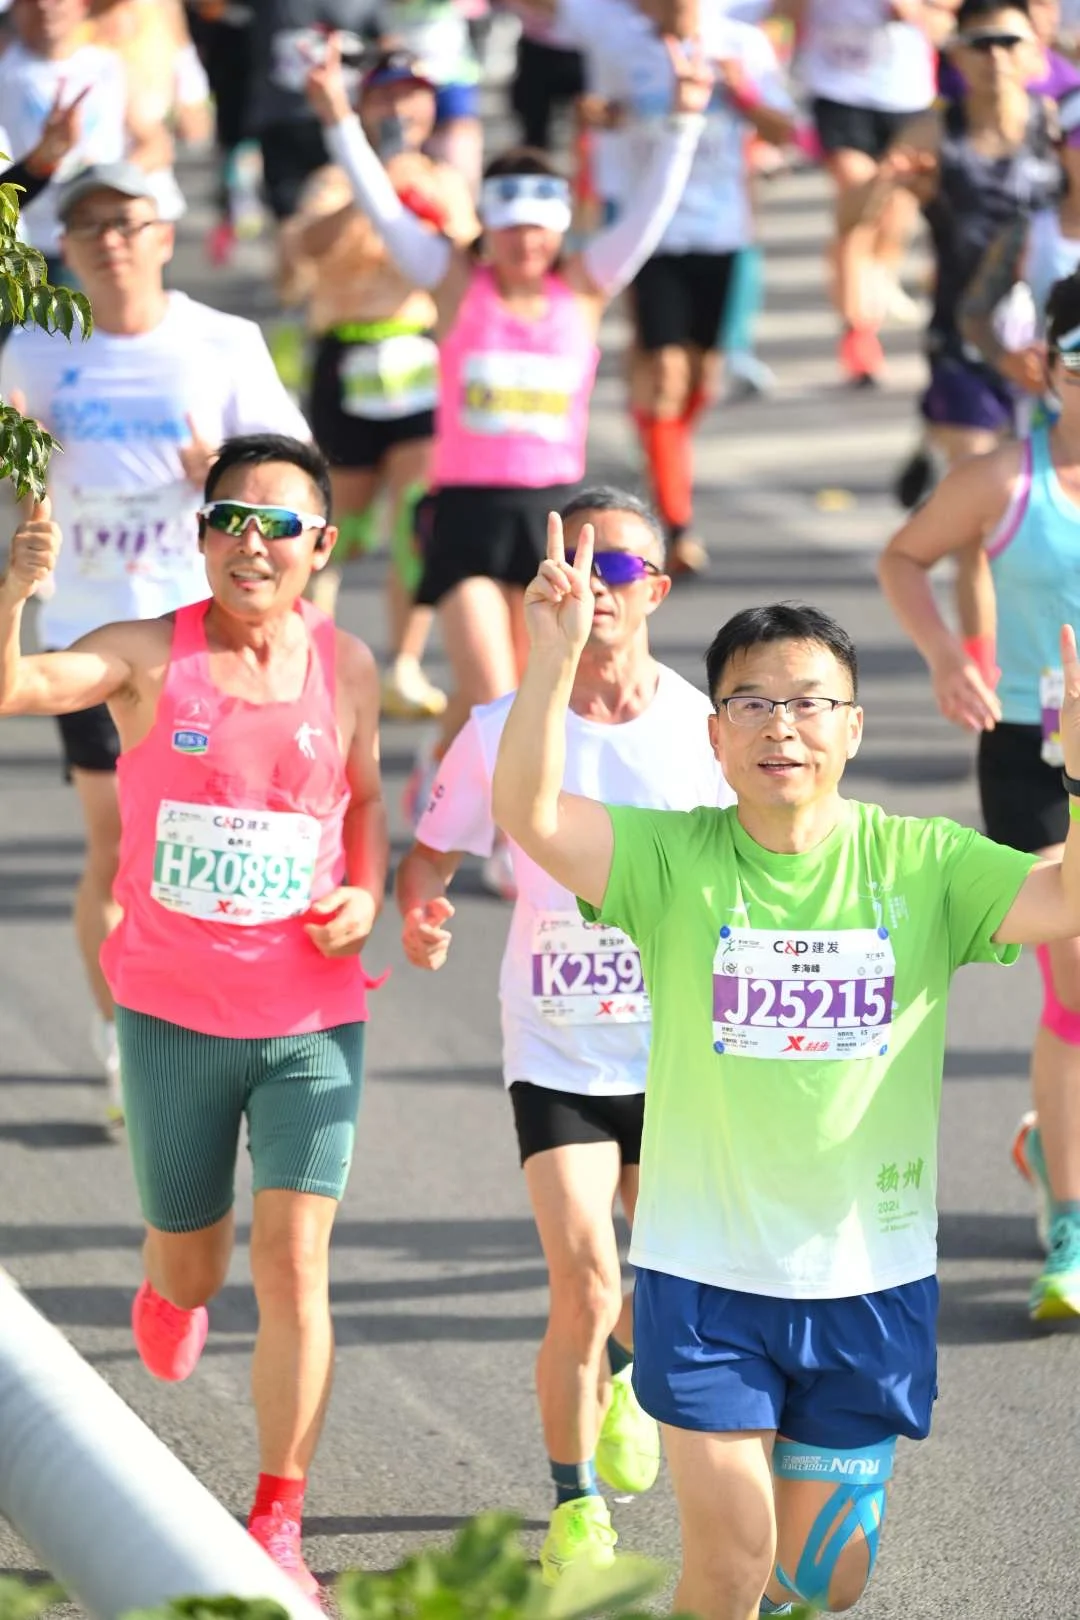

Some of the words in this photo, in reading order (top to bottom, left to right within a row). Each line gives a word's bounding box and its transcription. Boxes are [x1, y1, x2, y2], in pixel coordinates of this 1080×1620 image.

[160, 845, 312, 900] H20895
[773, 940, 808, 956] C&D
[811, 941, 840, 954] 建发
[724, 978, 887, 1028] J25215
[876, 1157, 924, 1193] 扬州
[829, 1456, 881, 1475] RUN
